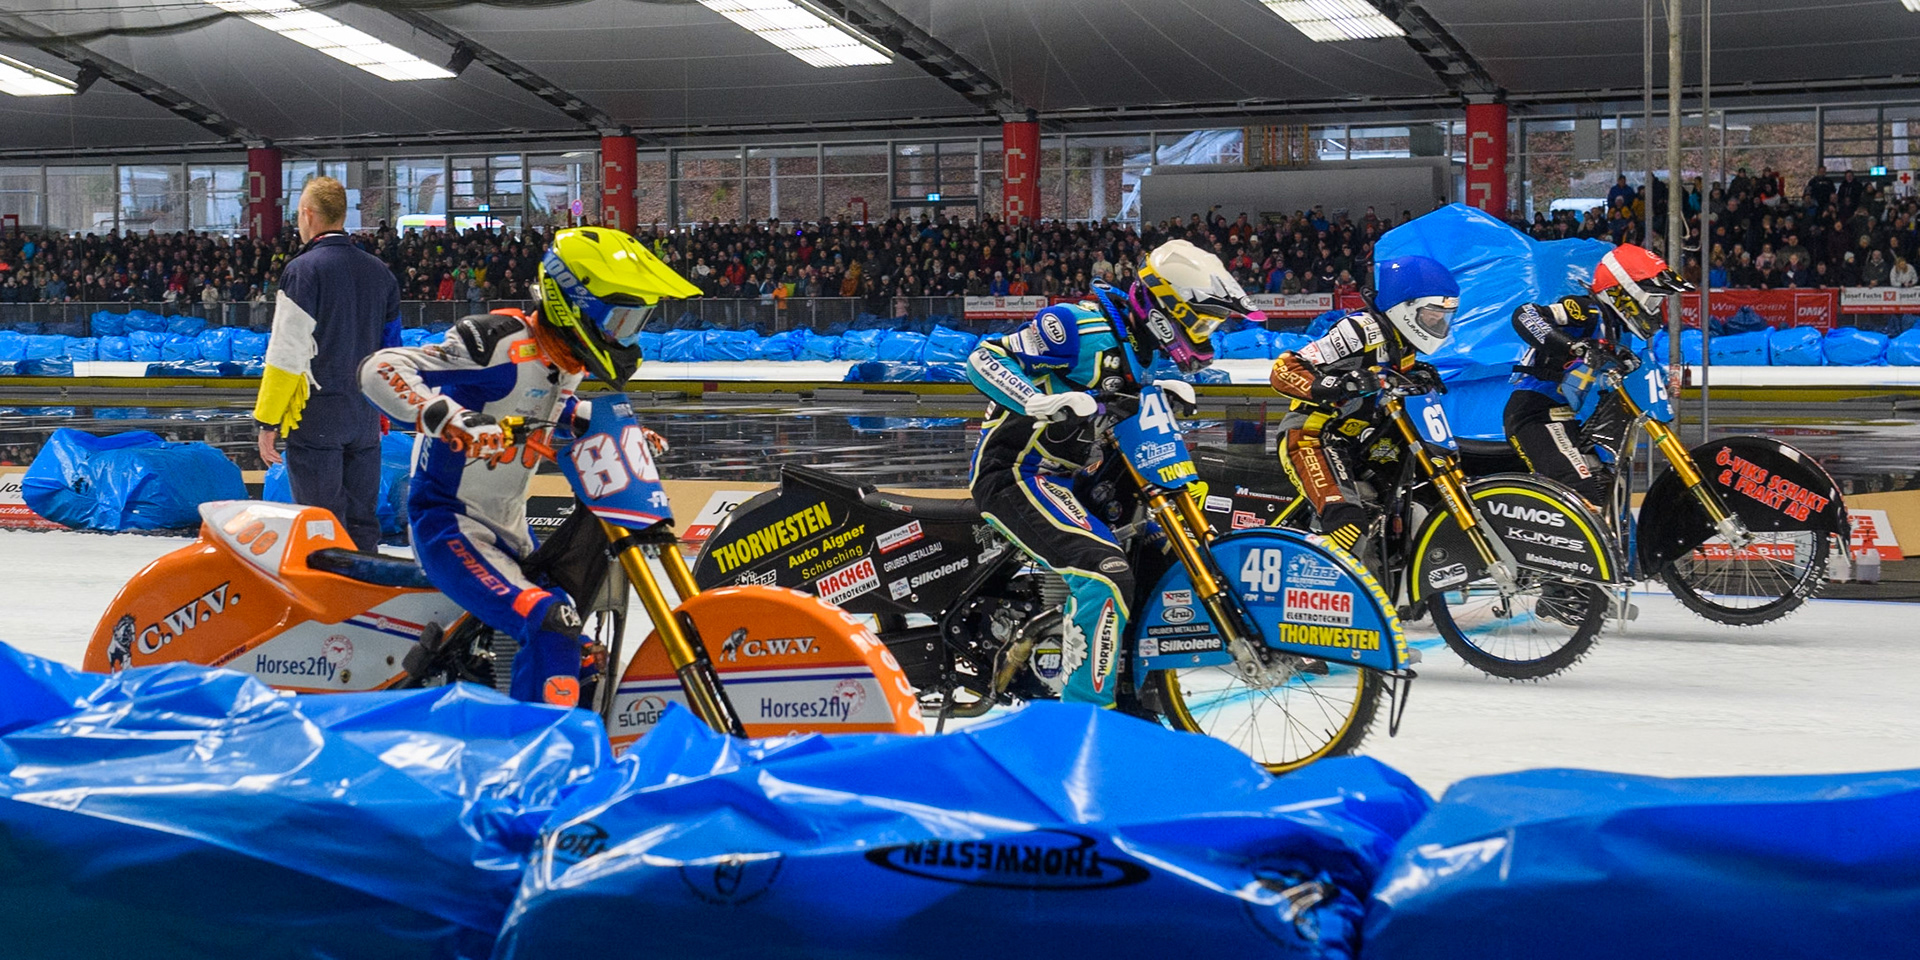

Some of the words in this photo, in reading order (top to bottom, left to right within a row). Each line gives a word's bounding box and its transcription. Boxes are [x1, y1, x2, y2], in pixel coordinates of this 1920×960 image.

[1402, 314, 1429, 341] VUMOS
[1301, 446, 1328, 489] PERTU
[1715, 446, 1769, 483] Ö-VIKS
[1767, 474, 1829, 513] SCHAKT
[1718, 469, 1733, 487] &
[1734, 479, 1786, 511] FRAKT
[1784, 502, 1811, 522] AB
[1487, 500, 1566, 528] VUMOS
[712, 501, 832, 575] THORWESTEN
[788, 546, 819, 569] Auto
[822, 523, 866, 554] Aigner
[1507, 527, 1584, 550] KJMPS
[802, 544, 864, 580] Schleching
[910, 557, 970, 589] Silkolene
[1240, 548, 1283, 594] 48
[1580, 563, 1594, 574] Oy
[818, 560, 875, 599] HACHER
[826, 578, 878, 605] EKTROTECHNIK
[1286, 590, 1351, 613] HACHER
[137, 581, 241, 655] C.W.V.
[1286, 612, 1350, 626] ELEKTROTECHNIK
[743, 636, 820, 657] C.W.V.
[1097, 611, 1116, 678] THORWESTEN
[1159, 637, 1221, 653] Silkolene
[1278, 622, 1381, 651] THORWESTEN
[256, 653, 337, 682] Horses2fly
[761, 696, 851, 722] Horses2fly
